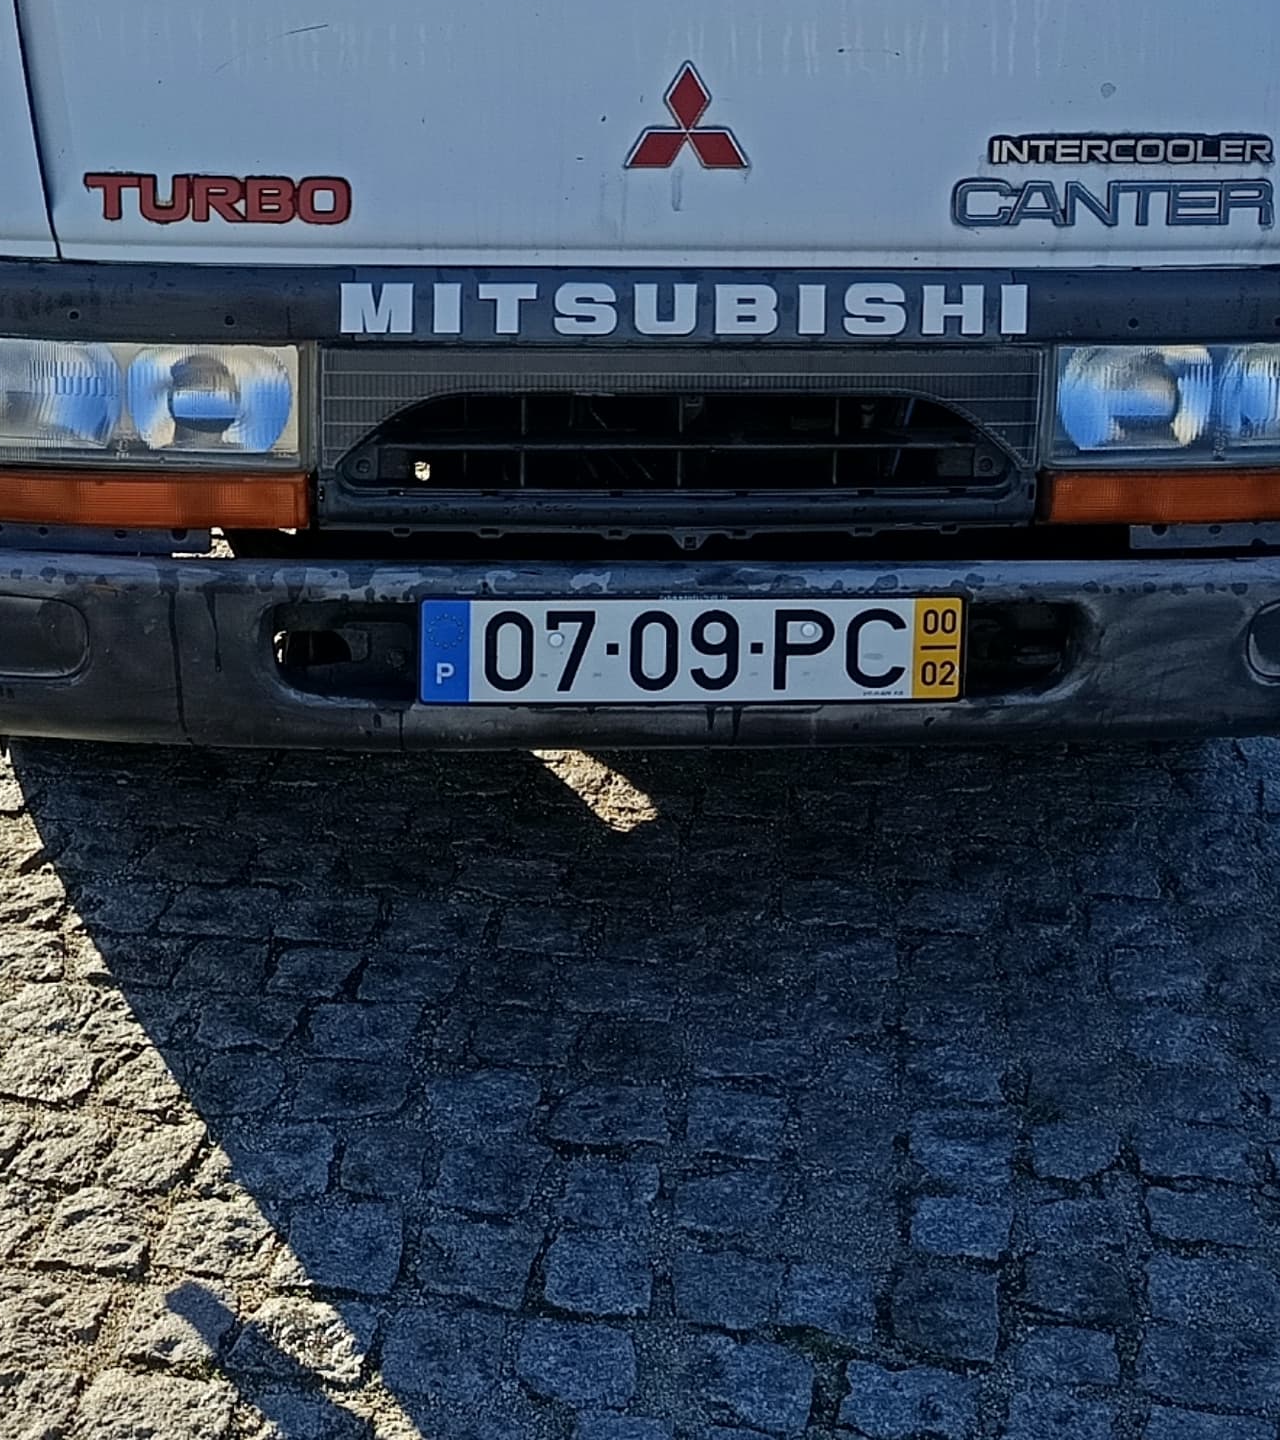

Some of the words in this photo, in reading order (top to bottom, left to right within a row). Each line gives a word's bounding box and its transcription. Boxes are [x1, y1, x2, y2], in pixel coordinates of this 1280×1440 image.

[992, 138, 1273, 164] INTERCOOLER
[83, 172, 352, 225] TURBO
[951, 177, 1274, 228] CANTER
[339, 282, 1029, 336] MITSUBISHI
[923, 609, 957, 635] 00
[436, 662, 455, 685] P
[921, 661, 956, 686] 02
